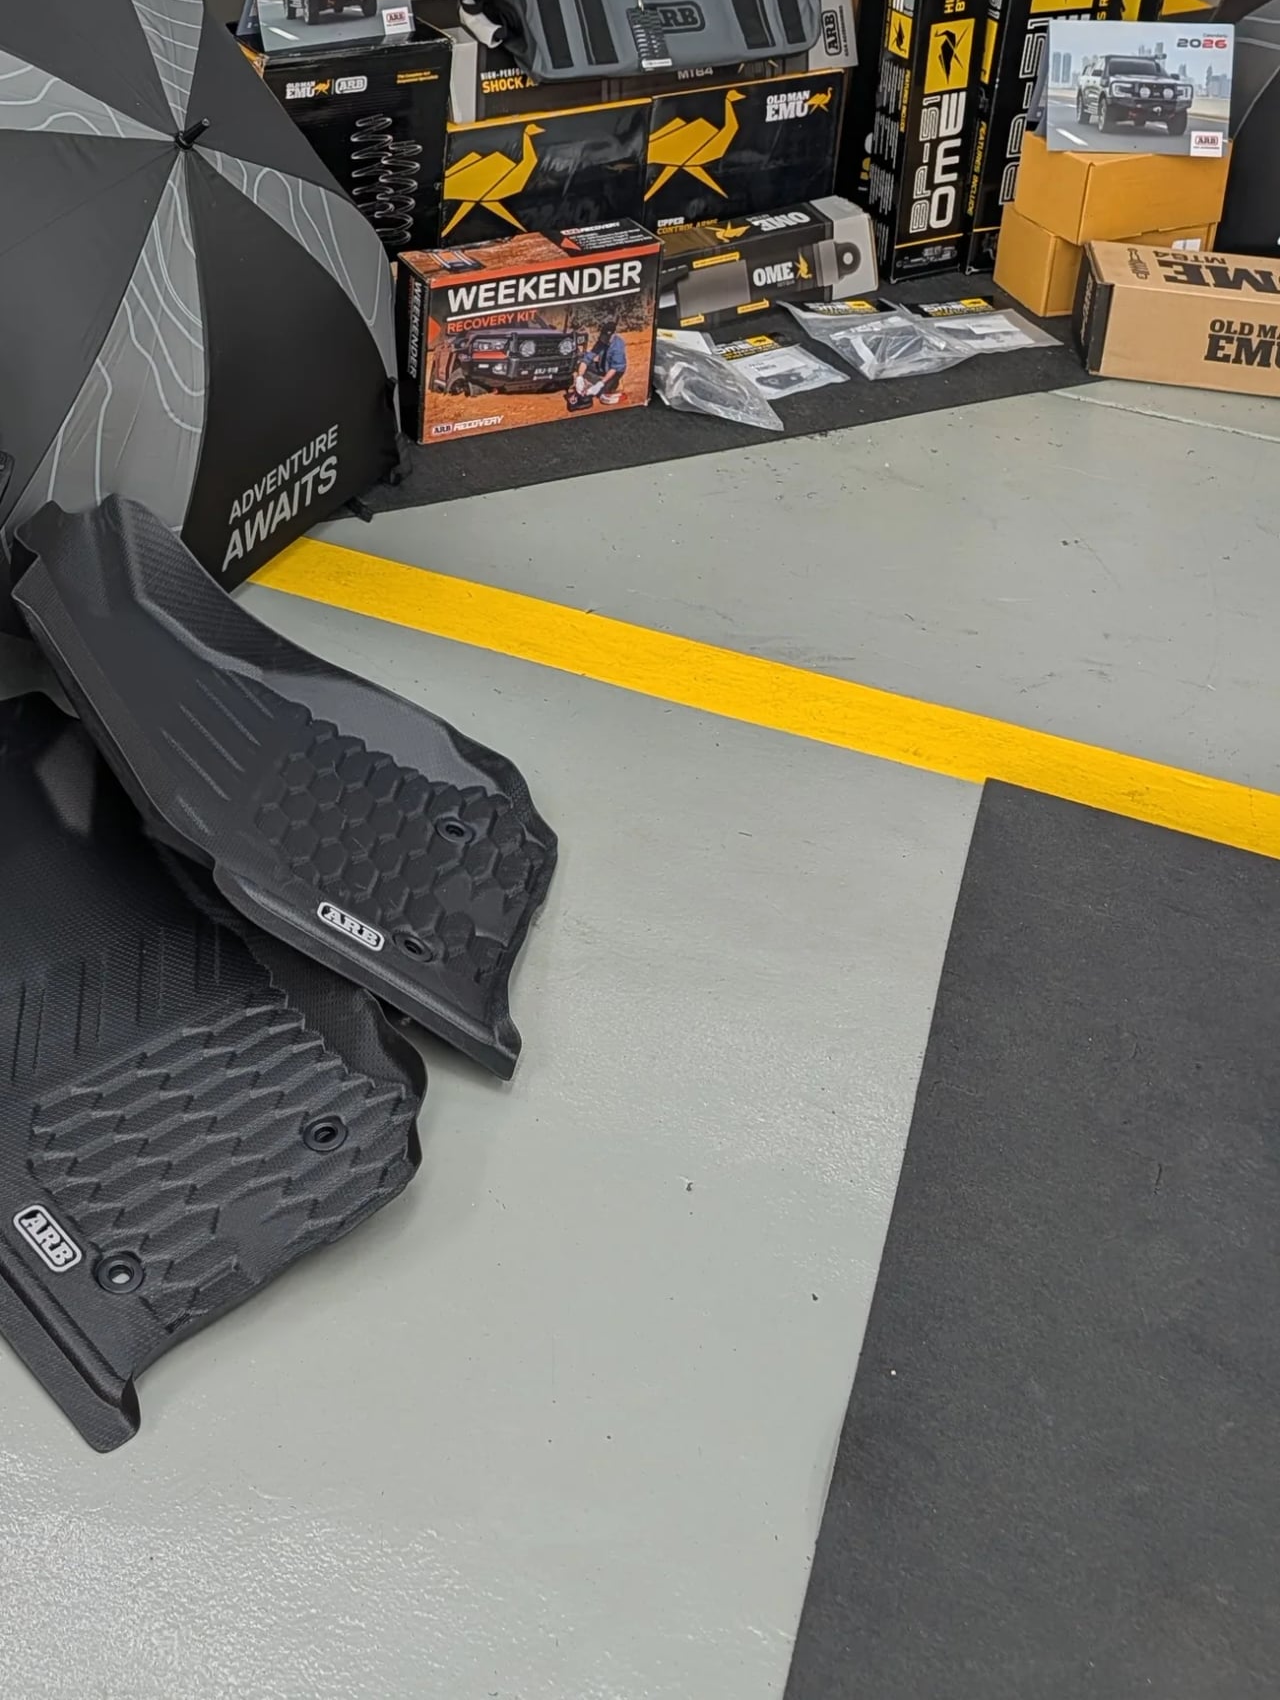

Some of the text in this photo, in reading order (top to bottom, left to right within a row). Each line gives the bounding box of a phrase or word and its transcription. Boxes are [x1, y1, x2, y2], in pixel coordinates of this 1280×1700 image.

[660, 6, 698, 28] RB
[1176, 38, 1227, 49] 2026
[285, 87, 315, 99] EMU
[286, 80, 315, 90] OLD MAN
[481, 76, 524, 94] SHOCK
[766, 90, 810, 104] OLD MAN
[765, 100, 808, 122] EMU
[909, 95, 941, 233] BP-51
[929, 91, 967, 229] OME
[657, 216, 685, 228] UPPER
[657, 223, 694, 235] CONTROL
[751, 211, 811, 232] OME
[1153, 250, 1227, 265] MT64
[753, 261, 795, 287] OME
[1157, 259, 1280, 295] ME
[447, 260, 643, 313] WEEKENDER
[407, 281, 422, 379] WEEKENDER
[447, 310, 537, 334] RECOVERY KIT
[1210, 318, 1255, 336] OLD
[453, 415, 504, 432] RECOVERY
[228, 424, 339, 525] ADVENTURE
[222, 455, 338, 572] AWAITS
